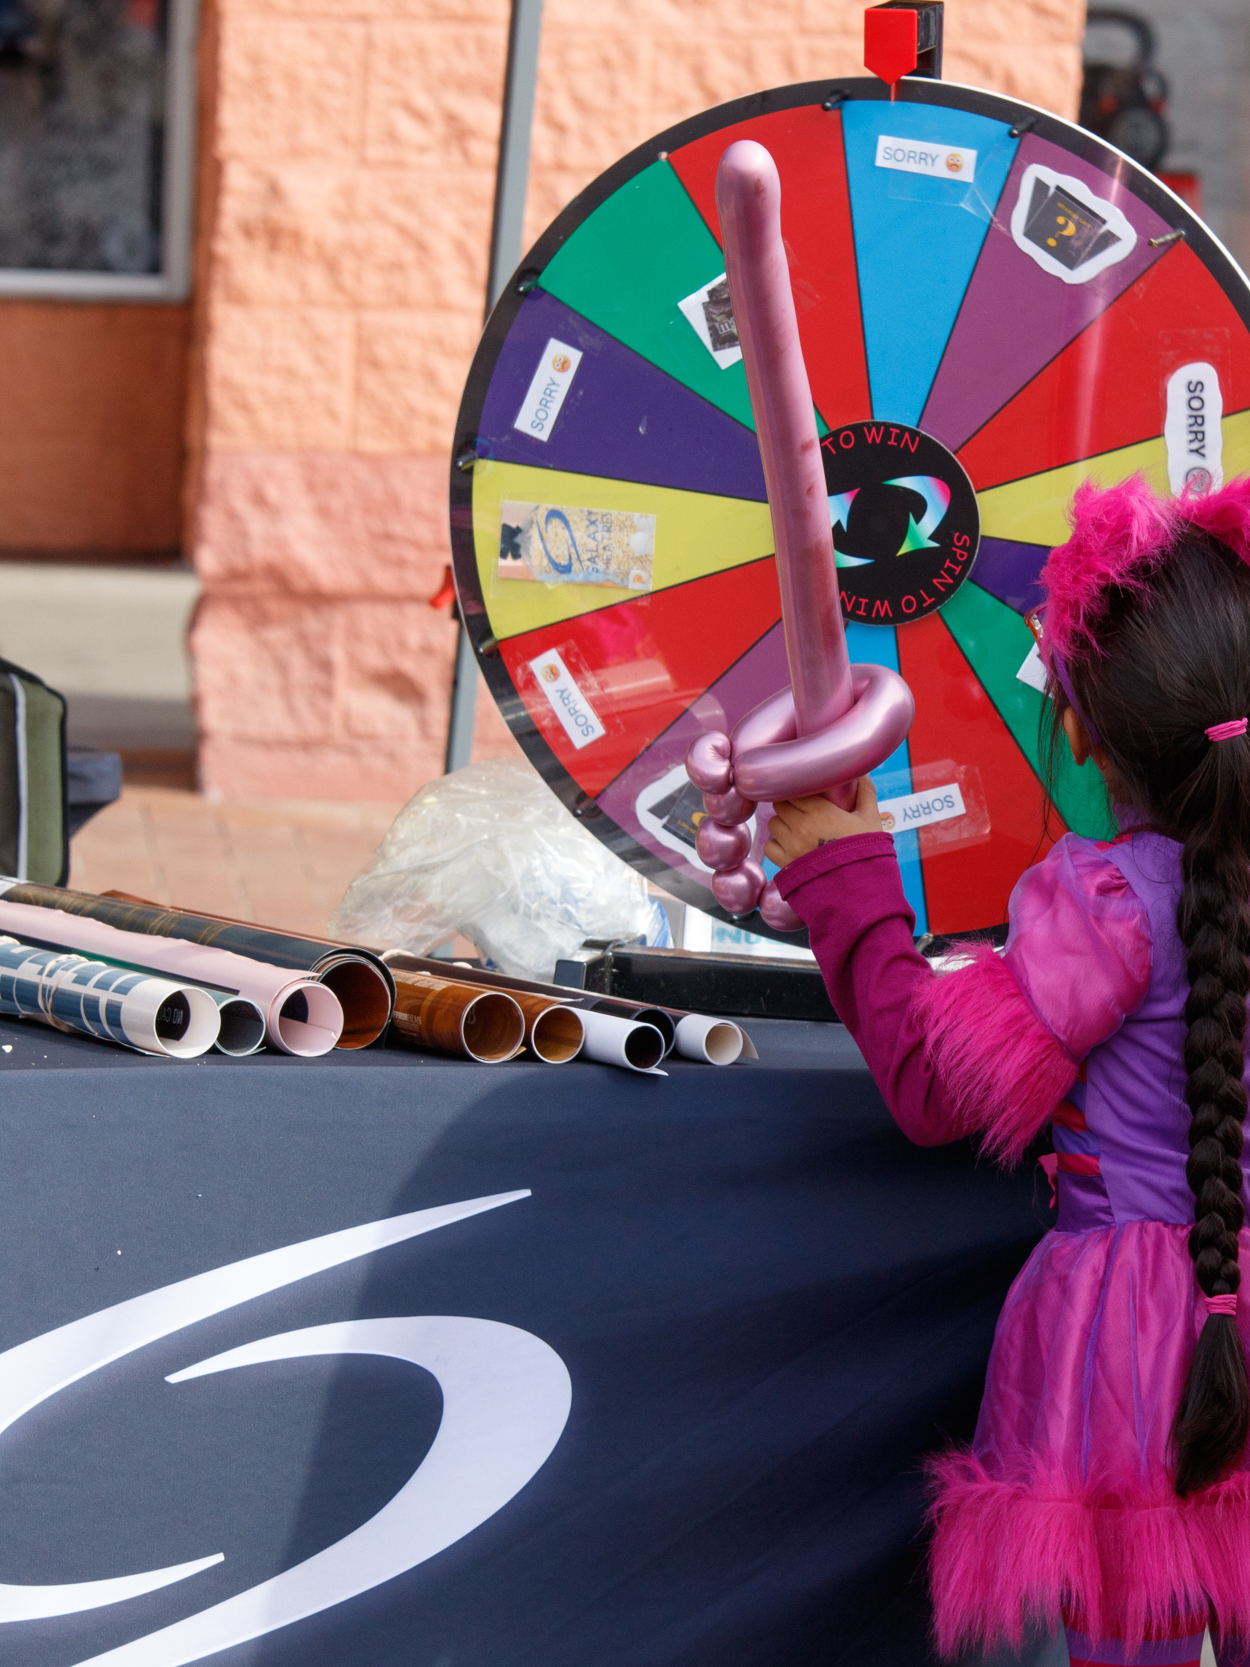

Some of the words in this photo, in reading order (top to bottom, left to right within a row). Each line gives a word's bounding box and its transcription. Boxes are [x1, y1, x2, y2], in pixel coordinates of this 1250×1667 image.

[882, 146, 939, 168] SORRY
[530, 376, 561, 433] SORRY
[1186, 379, 1207, 459] SORRY
[821, 430, 855, 456] TO
[865, 426, 919, 453] WIN
[586, 509, 599, 576] GALAXY
[602, 511, 613, 573] THEATRES
[932, 532, 971, 594] SPIN
[839, 590, 893, 618] WIN
[902, 592, 935, 613] TO
[555, 687, 595, 738] SORRY
[902, 795, 955, 823] SORRY
